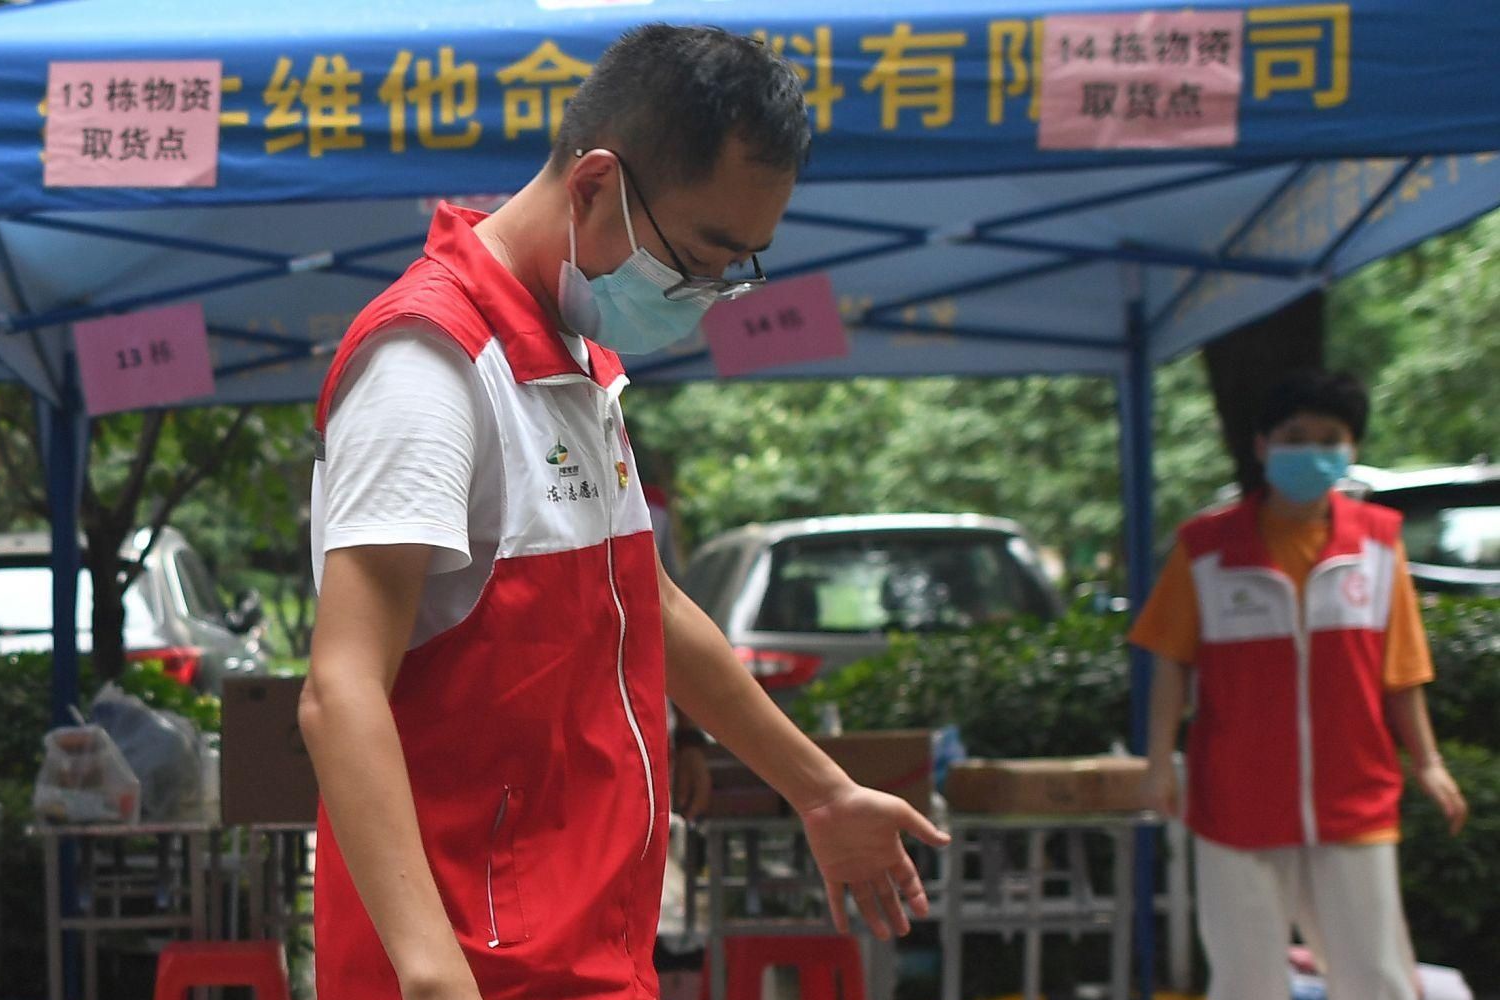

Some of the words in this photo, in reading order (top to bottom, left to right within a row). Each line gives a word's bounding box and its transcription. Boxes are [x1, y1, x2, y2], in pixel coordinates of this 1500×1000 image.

[1060, 34, 1097, 64] 14
[62, 82, 95, 109] 13
[105, 77, 212, 113] 栋物资
[80, 126, 189, 161] 取货点
[116, 346, 143, 370] 13
